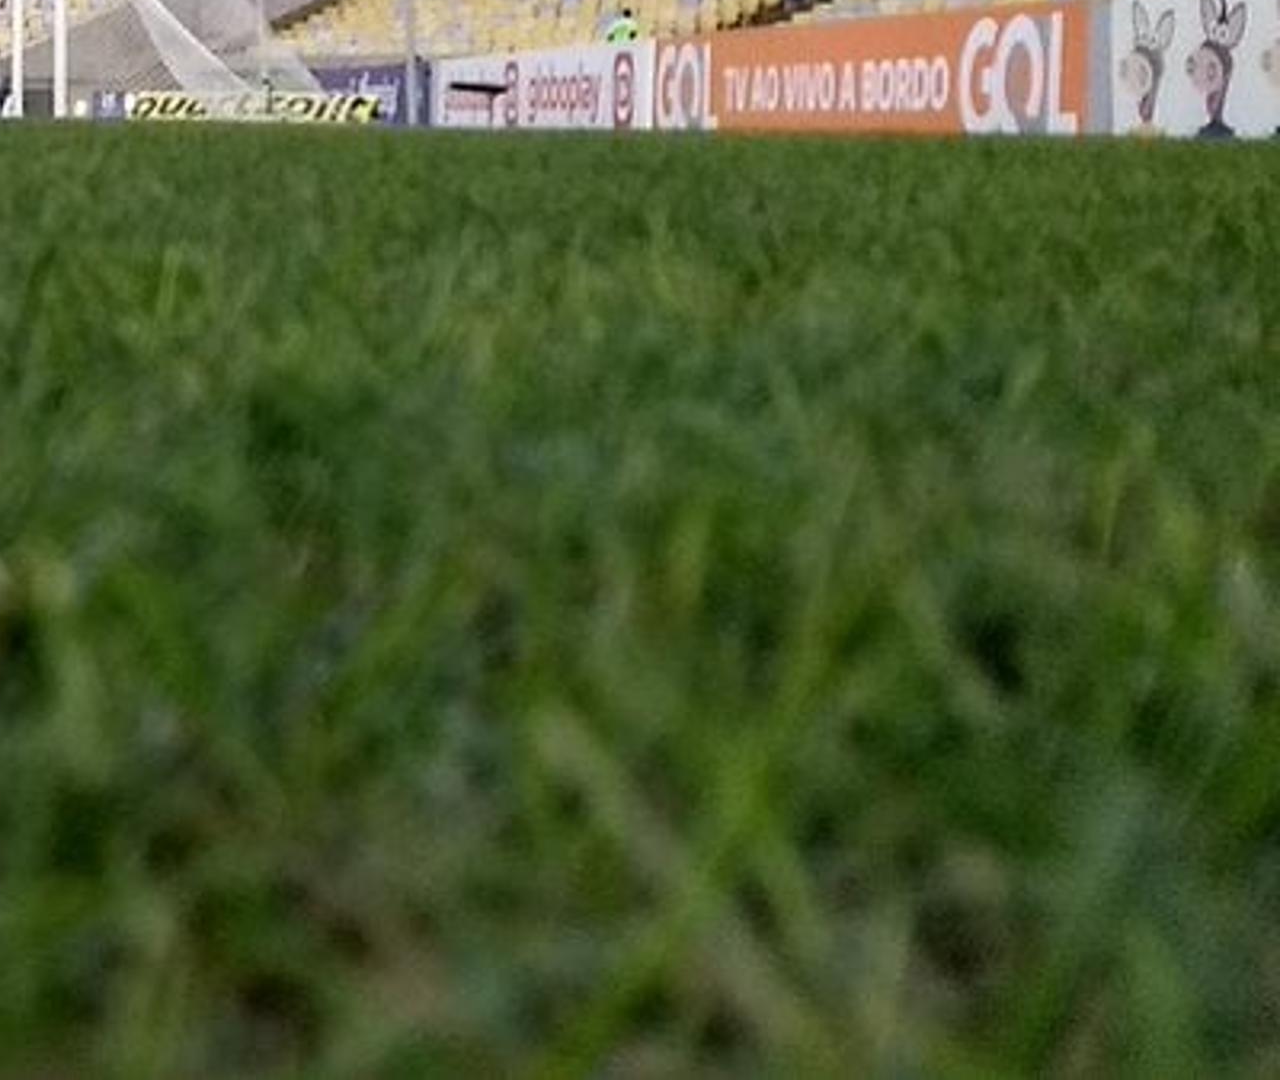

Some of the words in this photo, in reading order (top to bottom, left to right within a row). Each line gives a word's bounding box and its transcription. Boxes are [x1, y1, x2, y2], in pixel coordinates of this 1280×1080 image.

[656, 39, 718, 129] GOL
[723, 66, 748, 110] TV
[751, 62, 778, 110] AO
[781, 60, 835, 112] VIVO
[838, 61, 855, 109] A
[860, 56, 950, 110] BORDO
[957, 10, 1079, 136] GOL
